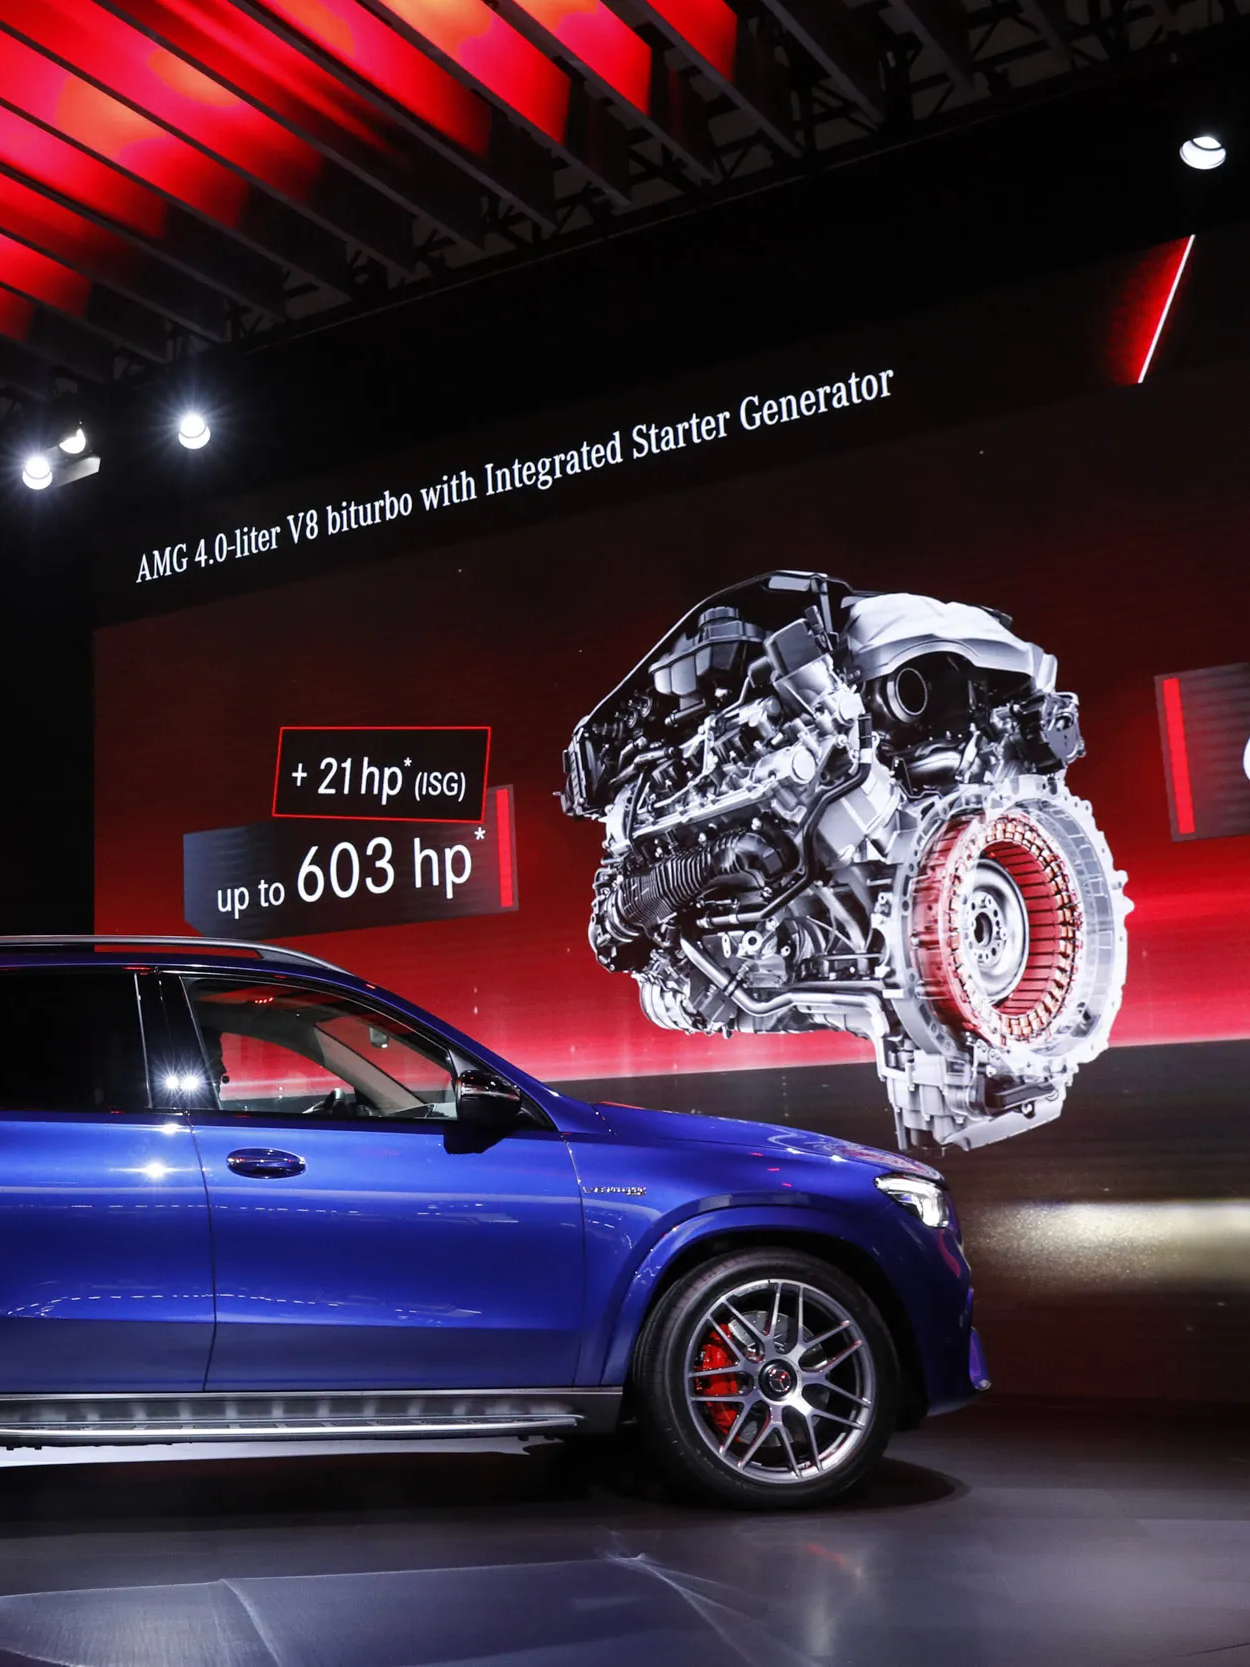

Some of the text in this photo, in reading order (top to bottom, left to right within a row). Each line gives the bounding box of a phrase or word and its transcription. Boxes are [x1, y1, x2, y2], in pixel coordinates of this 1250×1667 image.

[135, 369, 894, 584] AMG 4.0-liter V8 biturbo with Integrated Starter Generator
[317, 756, 352, 795] 21
[414, 771, 466, 803] (ISG)
[217, 886, 250, 920] up
[257, 879, 285, 908] to
[297, 836, 396, 903] 603
